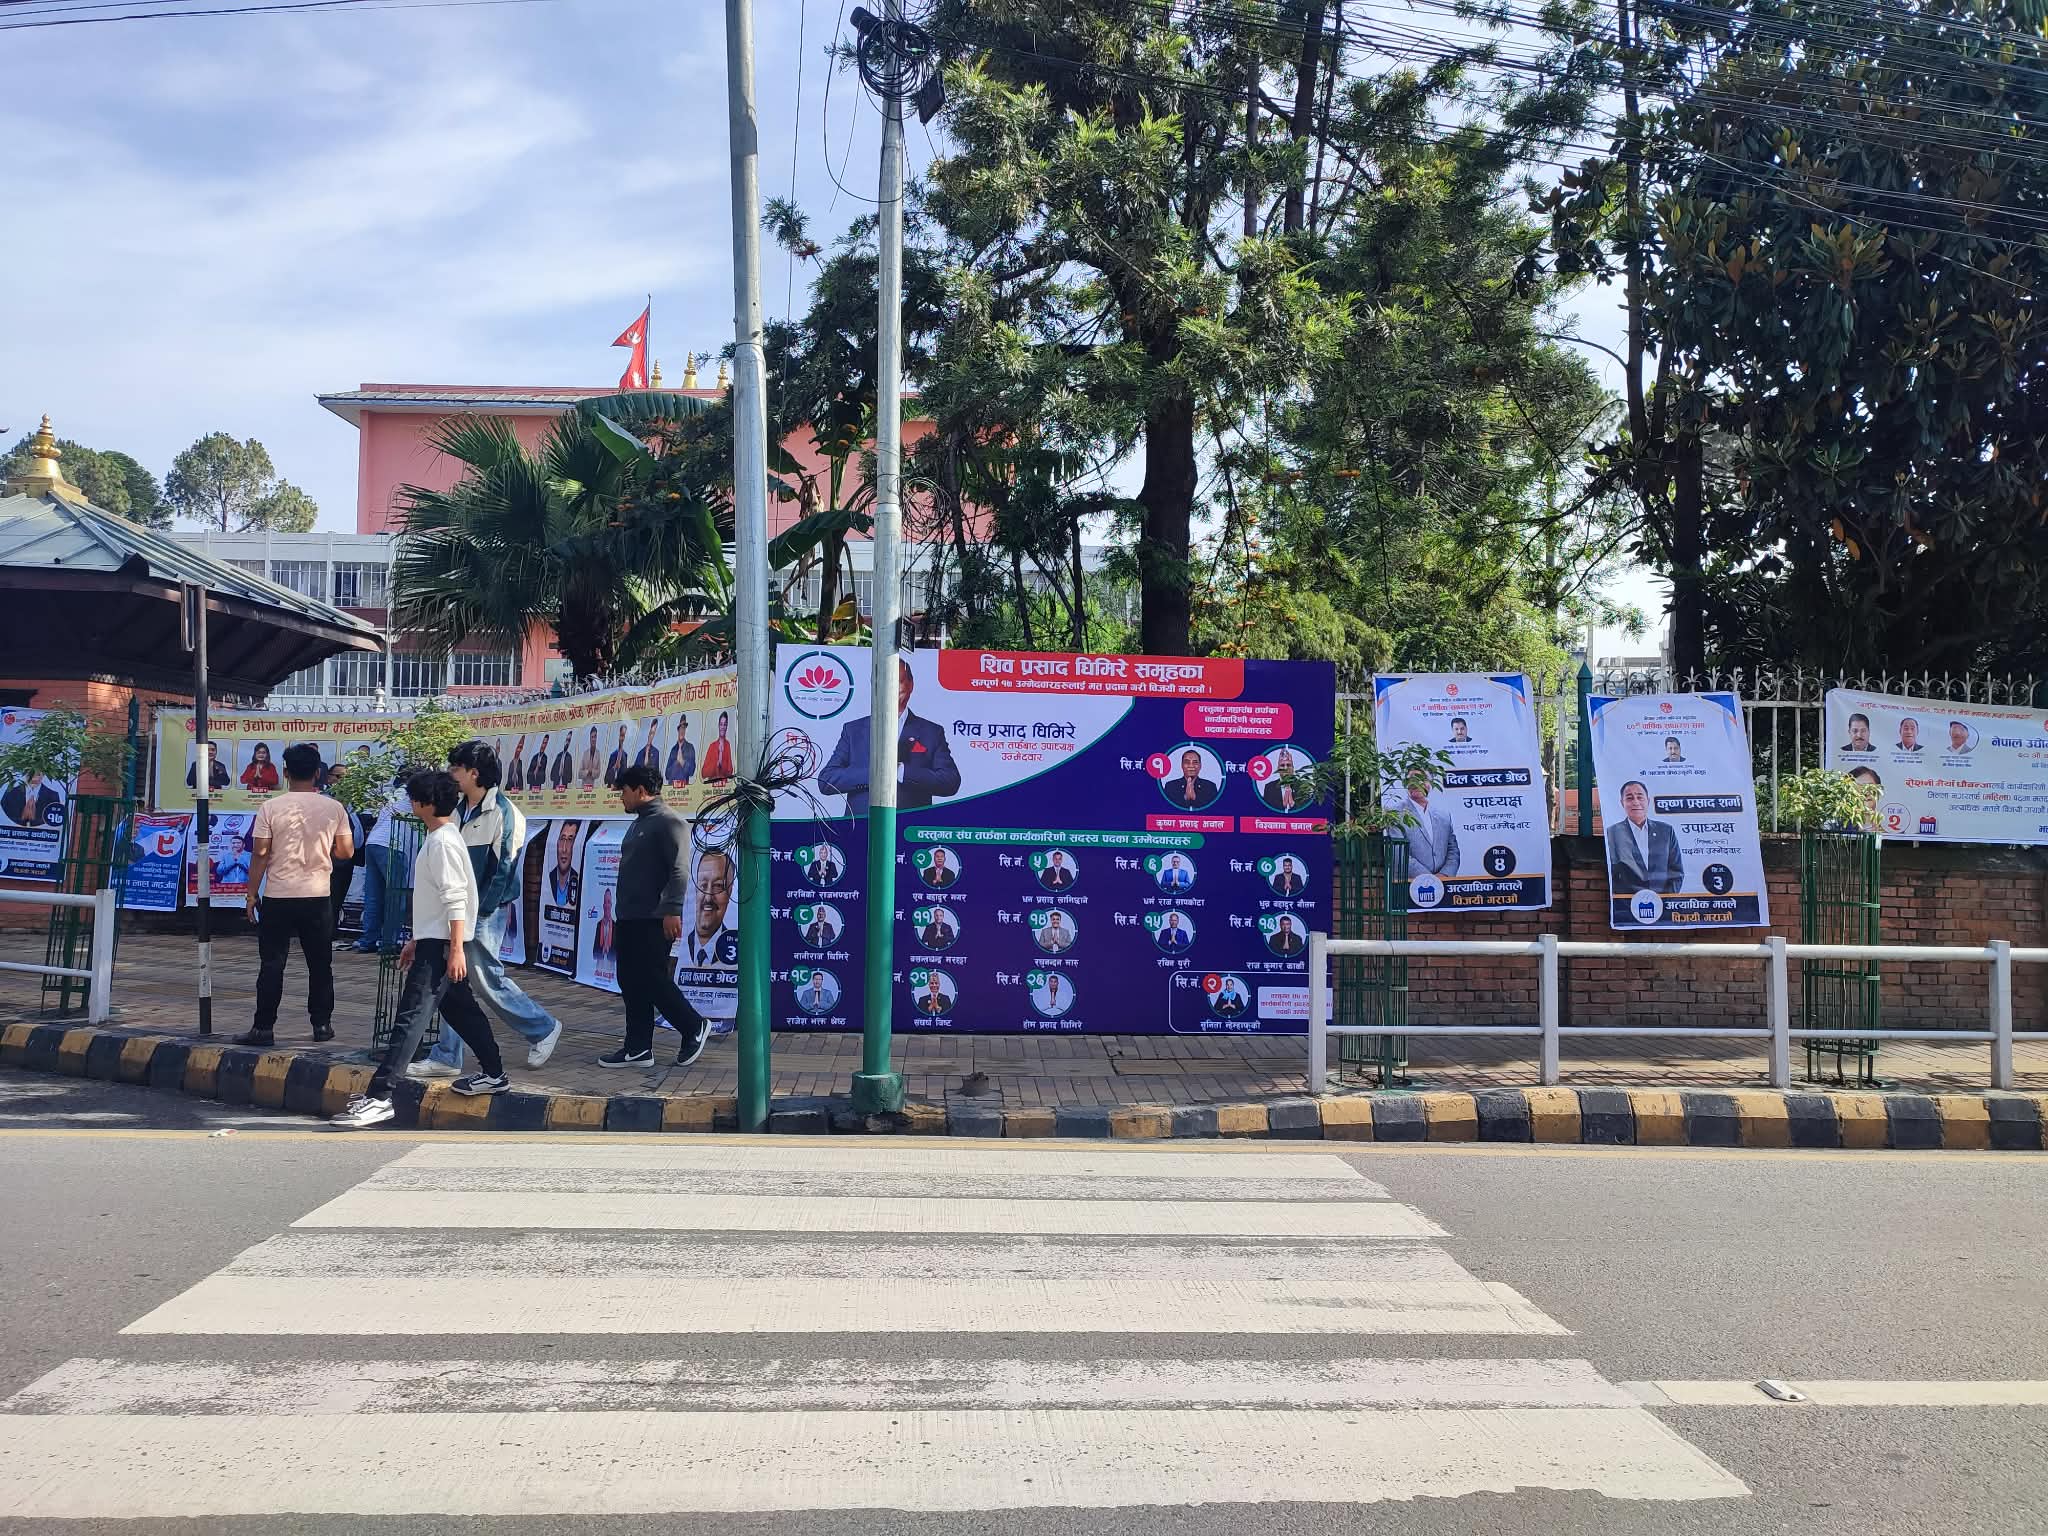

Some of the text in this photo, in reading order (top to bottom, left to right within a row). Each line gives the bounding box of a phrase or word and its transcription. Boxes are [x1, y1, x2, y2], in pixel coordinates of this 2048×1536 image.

[980, 653, 1204, 682] शिव प्रसाद घिमिरे समूहका
[243, 719, 275, 733] उद्योग
[281, 720, 328, 733] वाणिज्य
[953, 719, 1076, 739] शिव प्रसाद घिमिरे
[1992, 735, 2022, 748] नेपाल
[1152, 757, 1164, 773] १
[1253, 761, 1268, 777] २
[1446, 773, 1468, 785] दिल
[1505, 771, 1528, 782] श्रेष्ठ
[1463, 796, 1524, 808] उपाध्यक्ष
[1686, 798, 1715, 809] प्रसाद
[1718, 796, 1741, 807] शर्मा
[1680, 822, 1736, 835] उपाध्यक्ष
[1888, 814, 1901, 830] २
[917, 829, 953, 841] वस्तुगत
[956, 829, 973, 840] संघ
[1009, 831, 1066, 842] कार्यकारिणी
[1069, 833, 1099, 843] सदस्य
[1102, 834, 1129, 844] पदका
[799, 849, 808, 862] १
[916, 853, 926, 864] २
[1261, 861, 1272, 873] ७
[1713, 876, 1723, 890] ३
[1420, 892, 1434, 901] VOTE
[913, 910, 931, 923] ११
[725, 945, 737, 961] ३
[910, 971, 928, 984] २१
[1208, 976, 1217, 990] २
